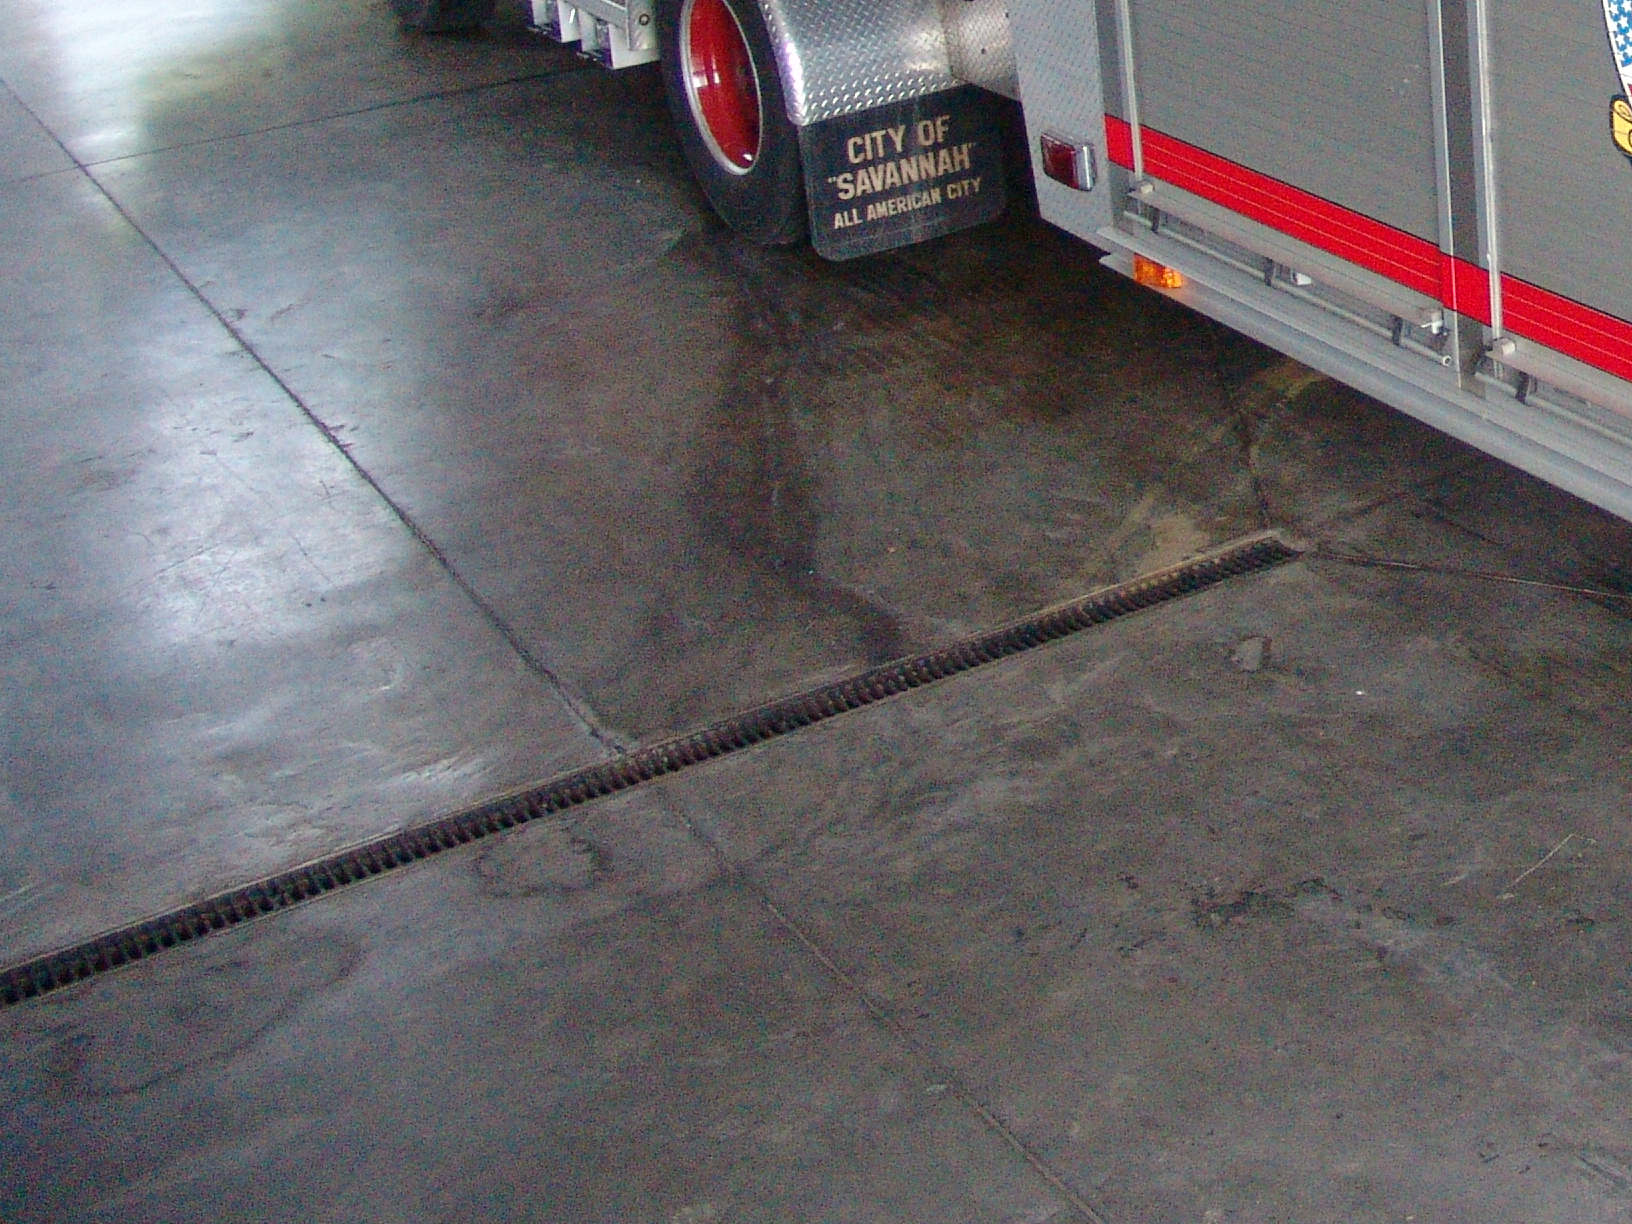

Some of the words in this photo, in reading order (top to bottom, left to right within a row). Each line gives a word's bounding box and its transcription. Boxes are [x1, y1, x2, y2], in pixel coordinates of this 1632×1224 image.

[847, 125, 906, 164] CITY
[917, 114, 951, 146] OF
[834, 208, 864, 230] ALL
[867, 187, 942, 222] AMERICAN
[946, 177, 982, 200] CITY
